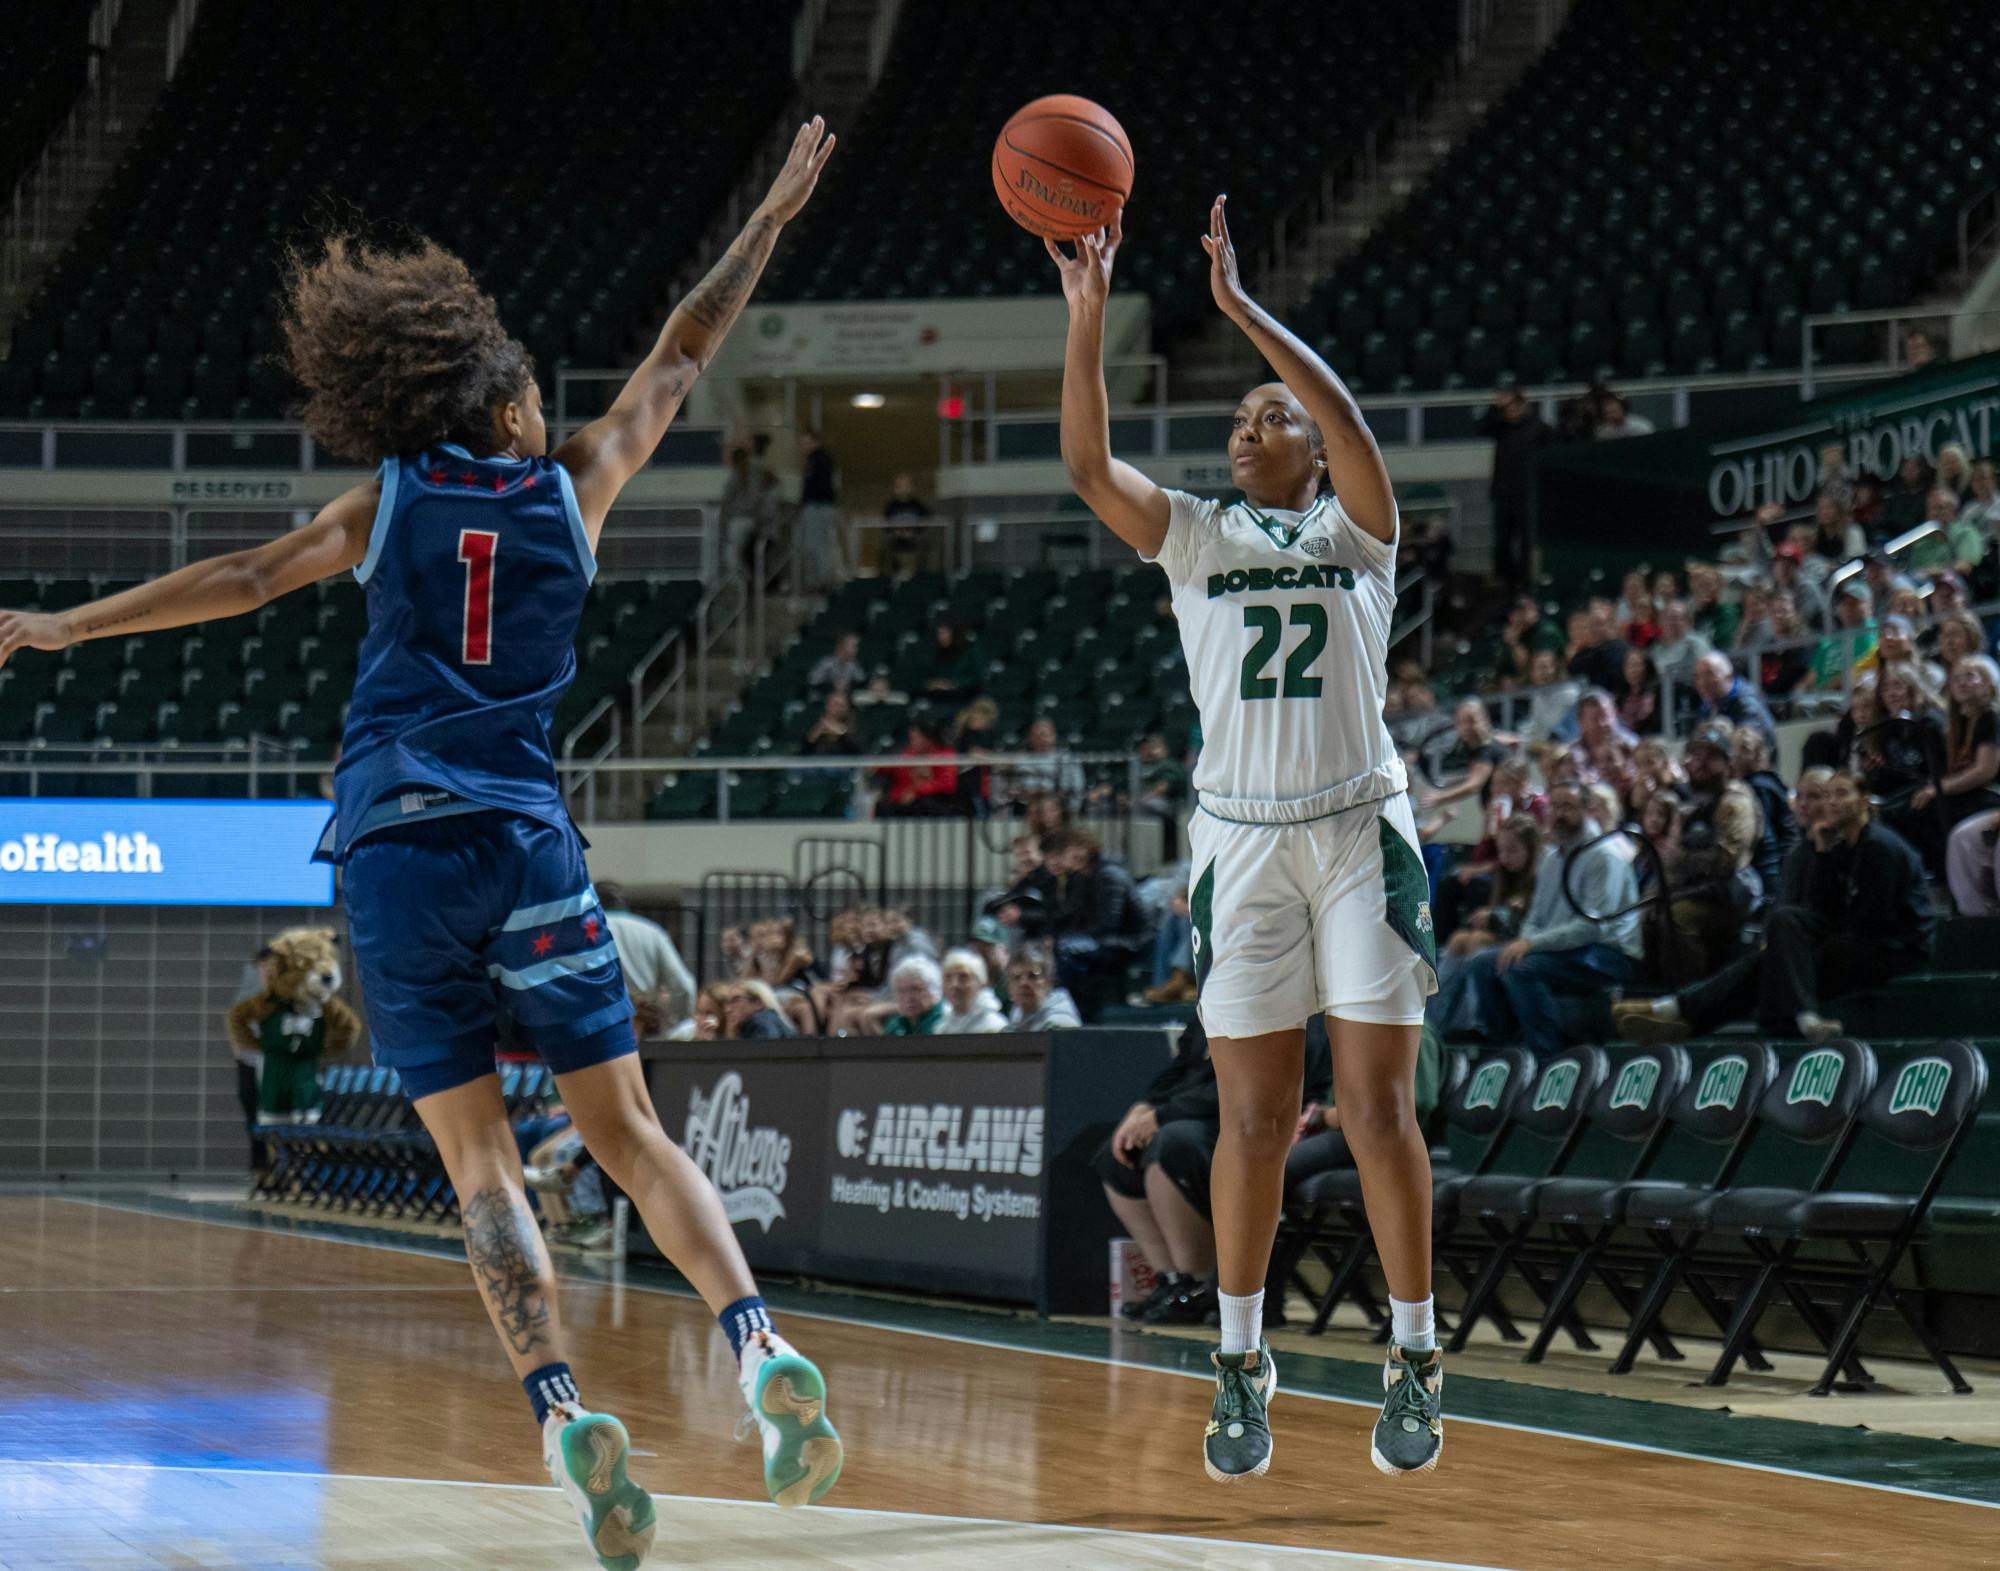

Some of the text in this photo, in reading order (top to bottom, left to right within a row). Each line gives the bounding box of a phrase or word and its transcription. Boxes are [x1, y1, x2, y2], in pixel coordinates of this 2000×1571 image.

[1015, 166, 1105, 219] SPALDING
[172, 481, 292, 499] RESERVED
[1709, 444, 1816, 517] OHIO
[457, 528, 499, 665] 1
[1207, 564, 1356, 600] BOBCATS
[1240, 603, 1328, 700] 22
[1609, 1057, 1660, 1111] OHIO
[1694, 1055, 1748, 1111] OHIO
[1786, 1050, 1844, 1107] OHIO
[1889, 1057, 1952, 1117] OHIO
[684, 1071, 792, 1195] Athens
[866, 1103, 1045, 1177] AIRCLAWS
[831, 1174, 891, 1214] Heating
[892, 1178, 907, 1208] &
[907, 1179, 970, 1221] Cooling
